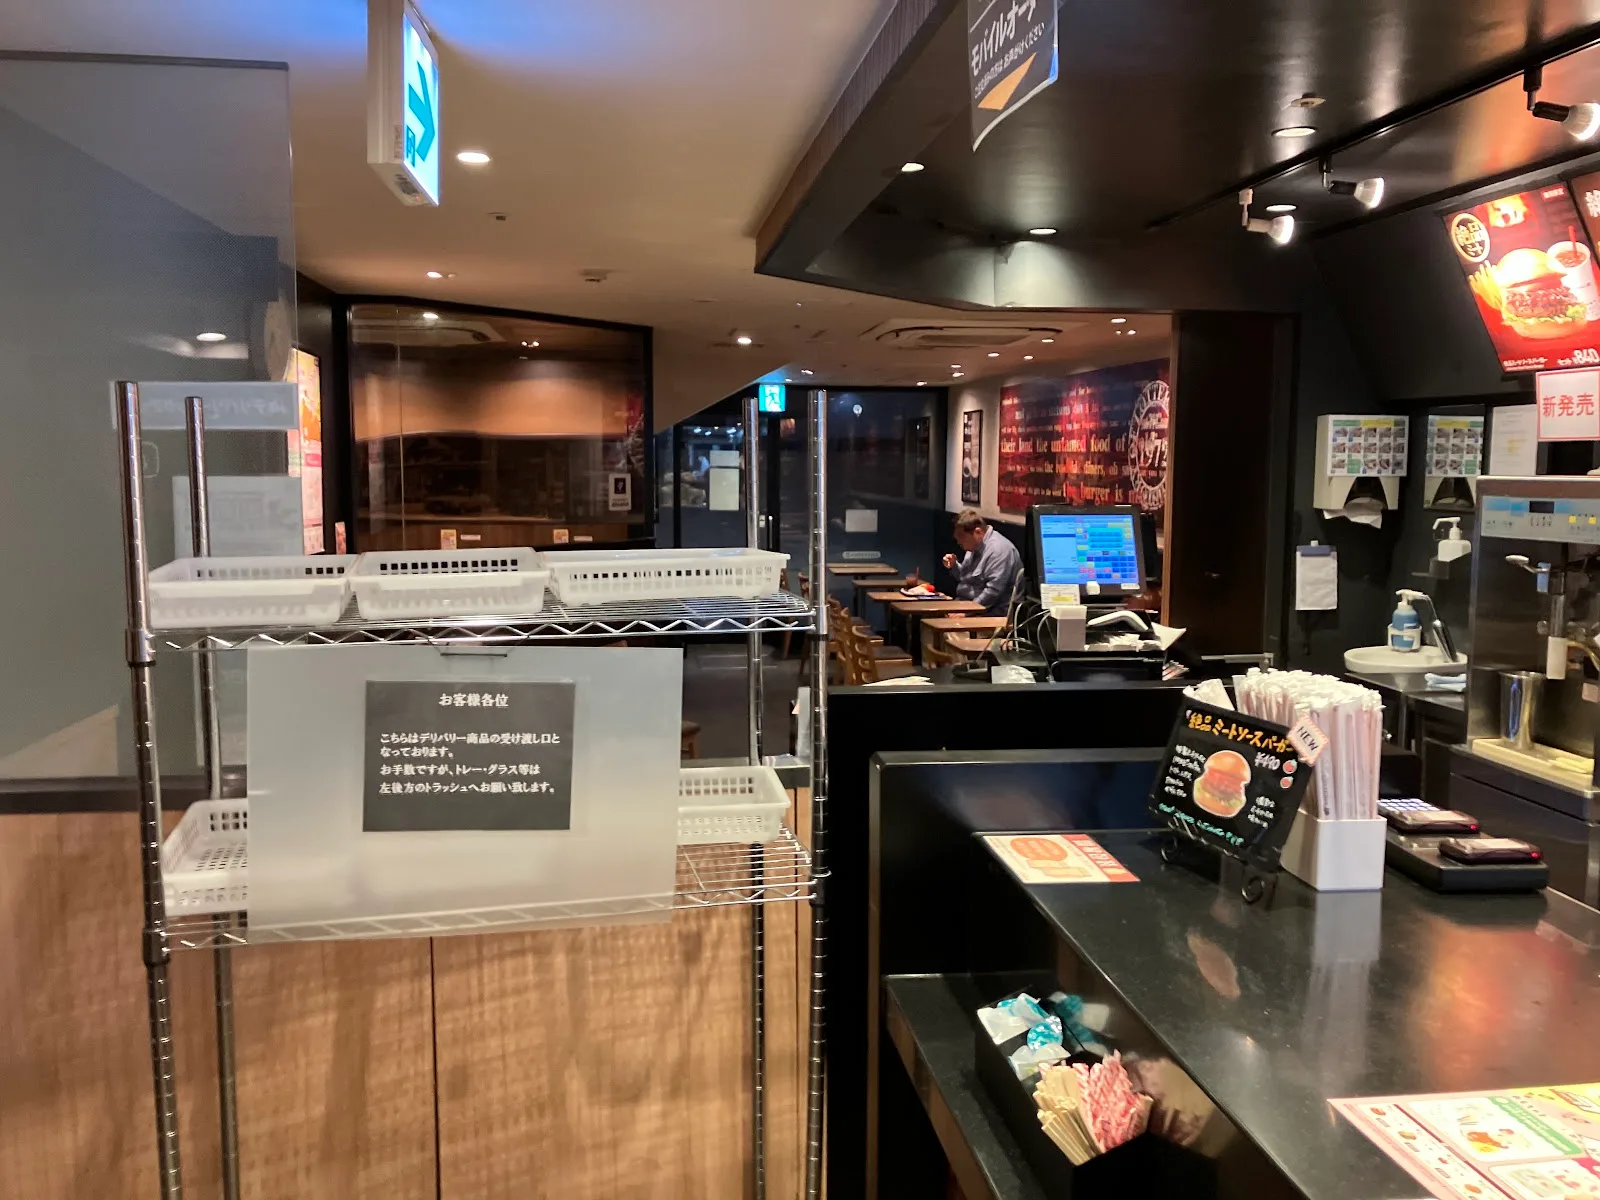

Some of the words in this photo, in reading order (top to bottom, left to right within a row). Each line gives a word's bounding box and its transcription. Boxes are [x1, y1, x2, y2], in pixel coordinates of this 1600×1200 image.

[1542, 393, 1595, 418] 新発売
[1090, 433, 1110, 453] food
[1115, 433, 1127, 452] of
[439, 693, 509, 707] お客様各位
[380, 732, 561, 744] こちらはデリバリー商品の受け渡し口と
[1297, 726, 1319, 752] NEW
[380, 746, 454, 758] なっております。
[379, 782, 556, 794] 左後方のトラッシュへお願い致します。
